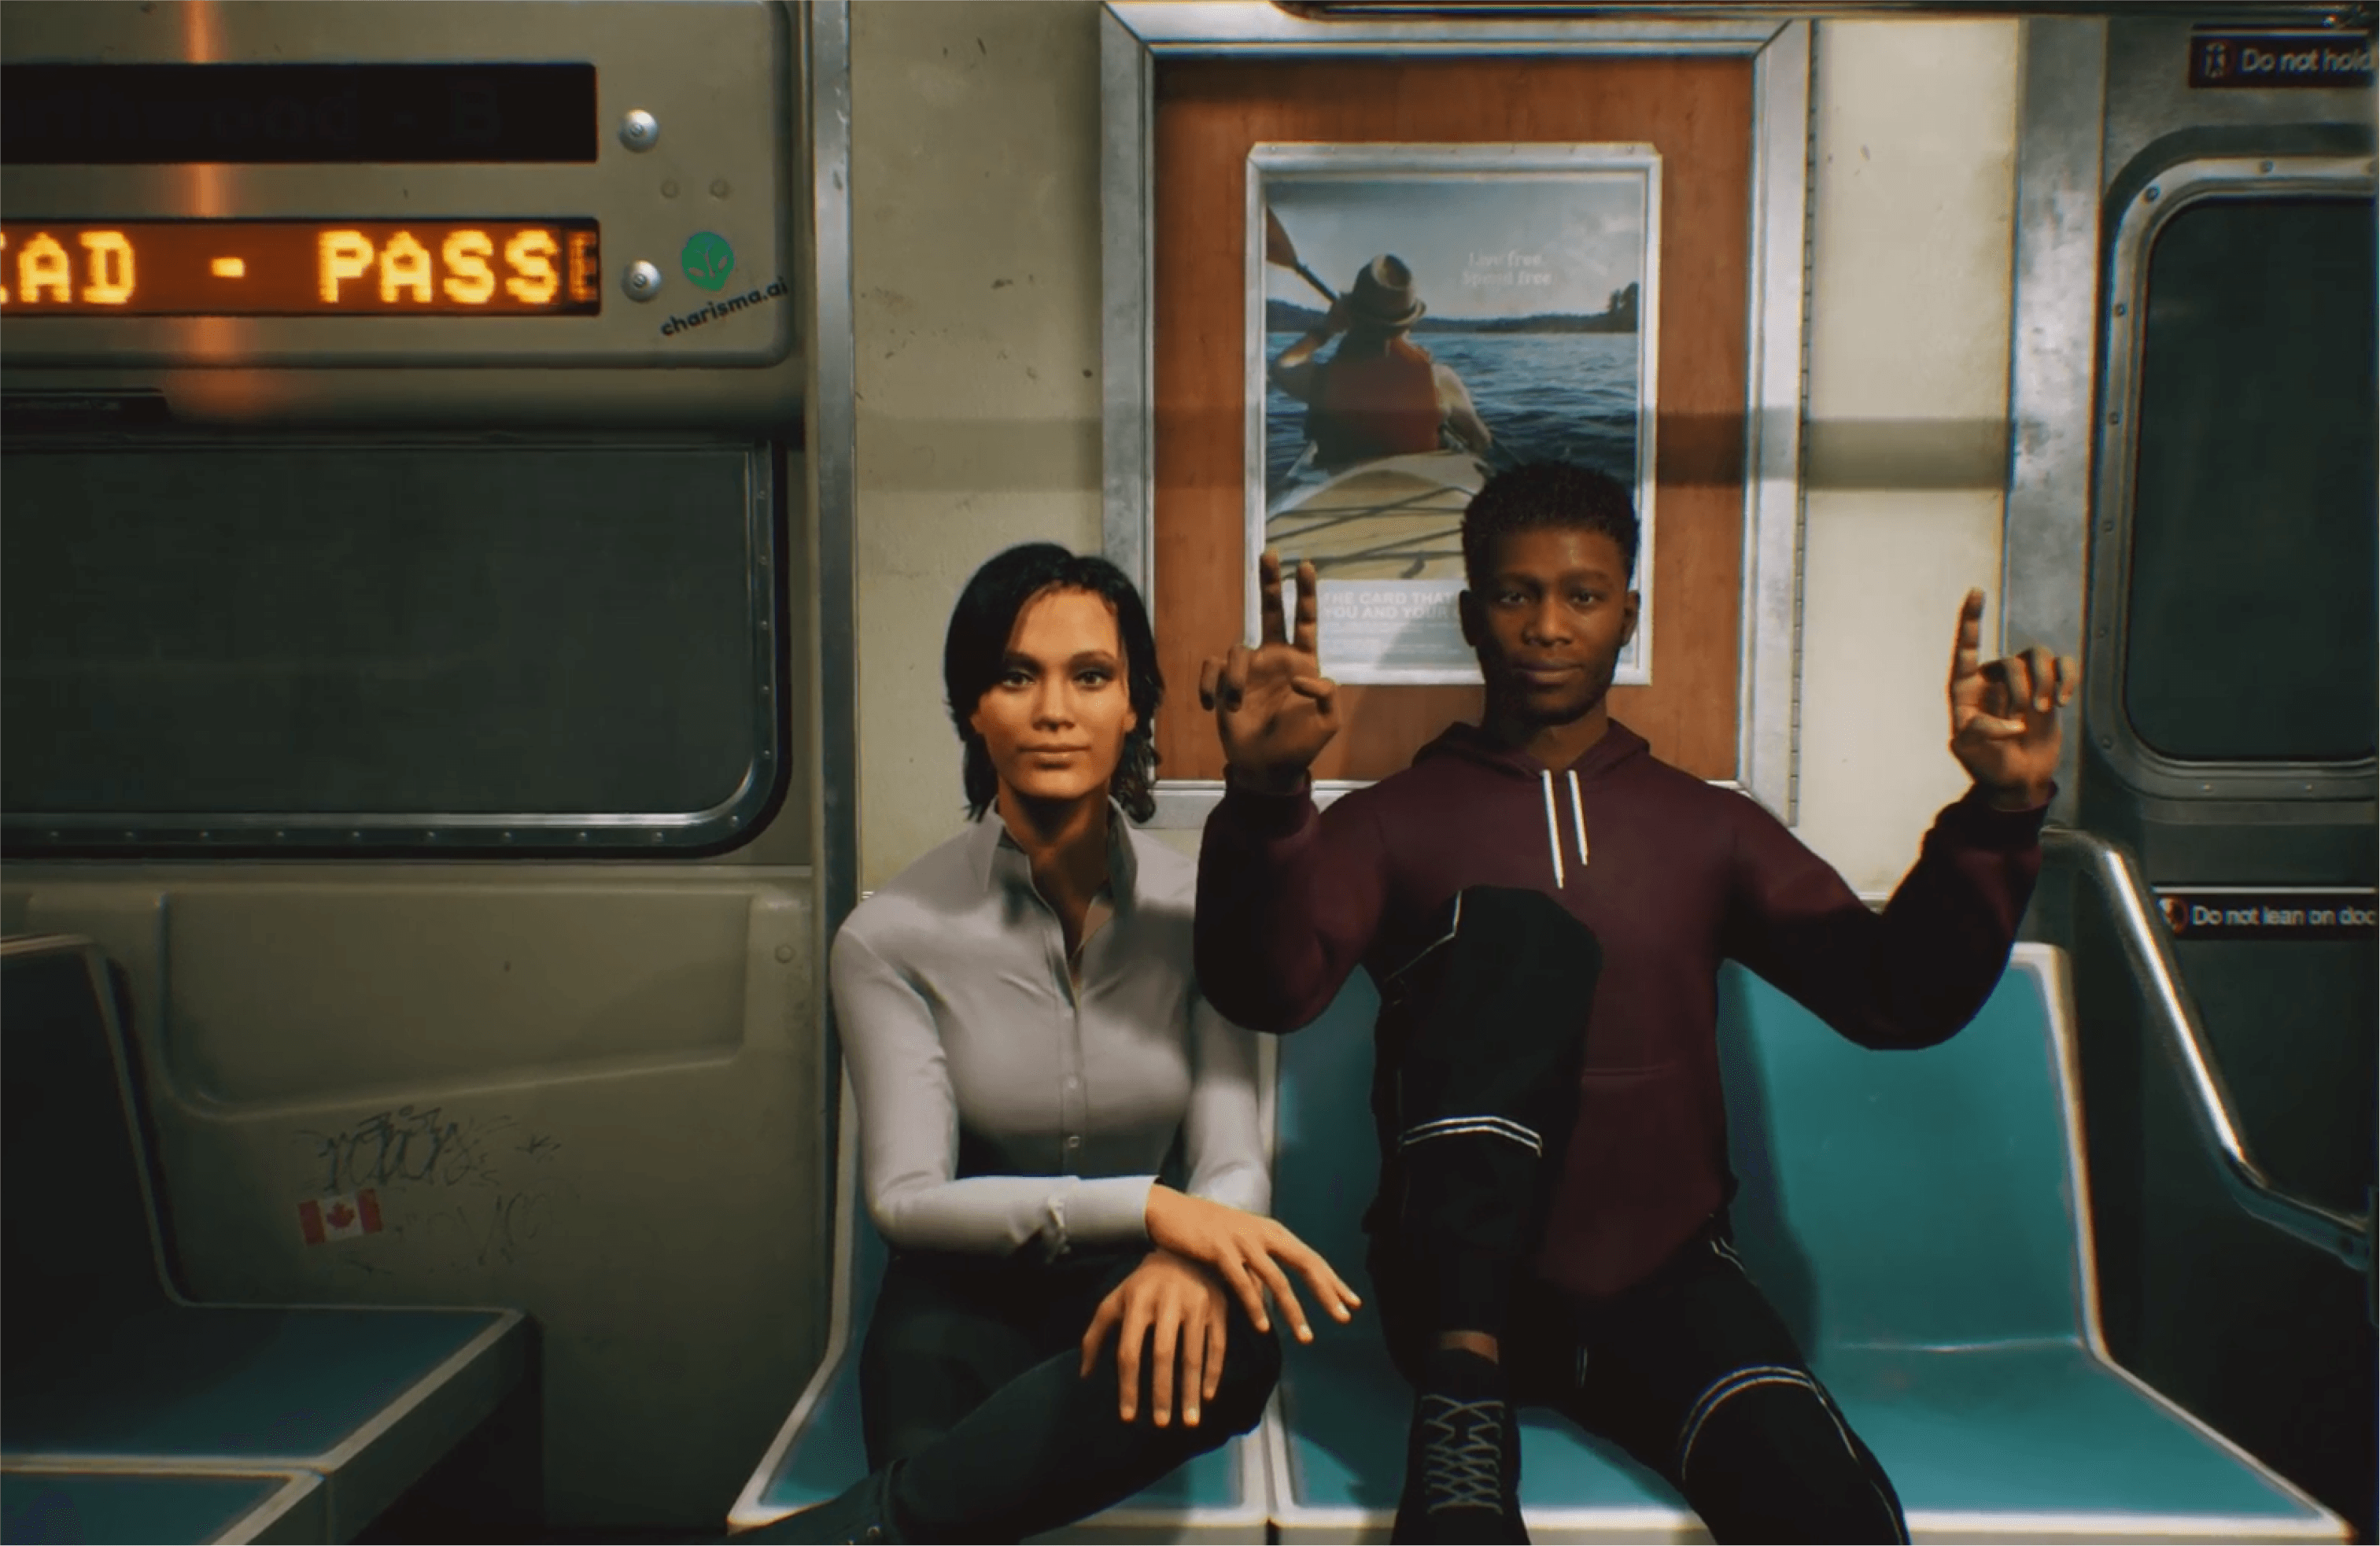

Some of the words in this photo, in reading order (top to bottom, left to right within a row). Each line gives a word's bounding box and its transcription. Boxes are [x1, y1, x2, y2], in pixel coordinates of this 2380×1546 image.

[2242, 47, 2275, 72] Do
[2280, 47, 2318, 72] not
[0, 230, 135, 304] AD
[660, 275, 789, 337] charisma.ai
[1359, 591, 1407, 605] CARD
[1411, 591, 1453, 604] THAT
[1323, 604, 1358, 619] YOU
[1361, 604, 1398, 619] AND
[1401, 604, 1448, 619] YOUR
[2192, 906, 2223, 925] Do
[2226, 906, 2260, 925] not
[2263, 905, 2304, 925] lean
[2308, 910, 2336, 925] on
